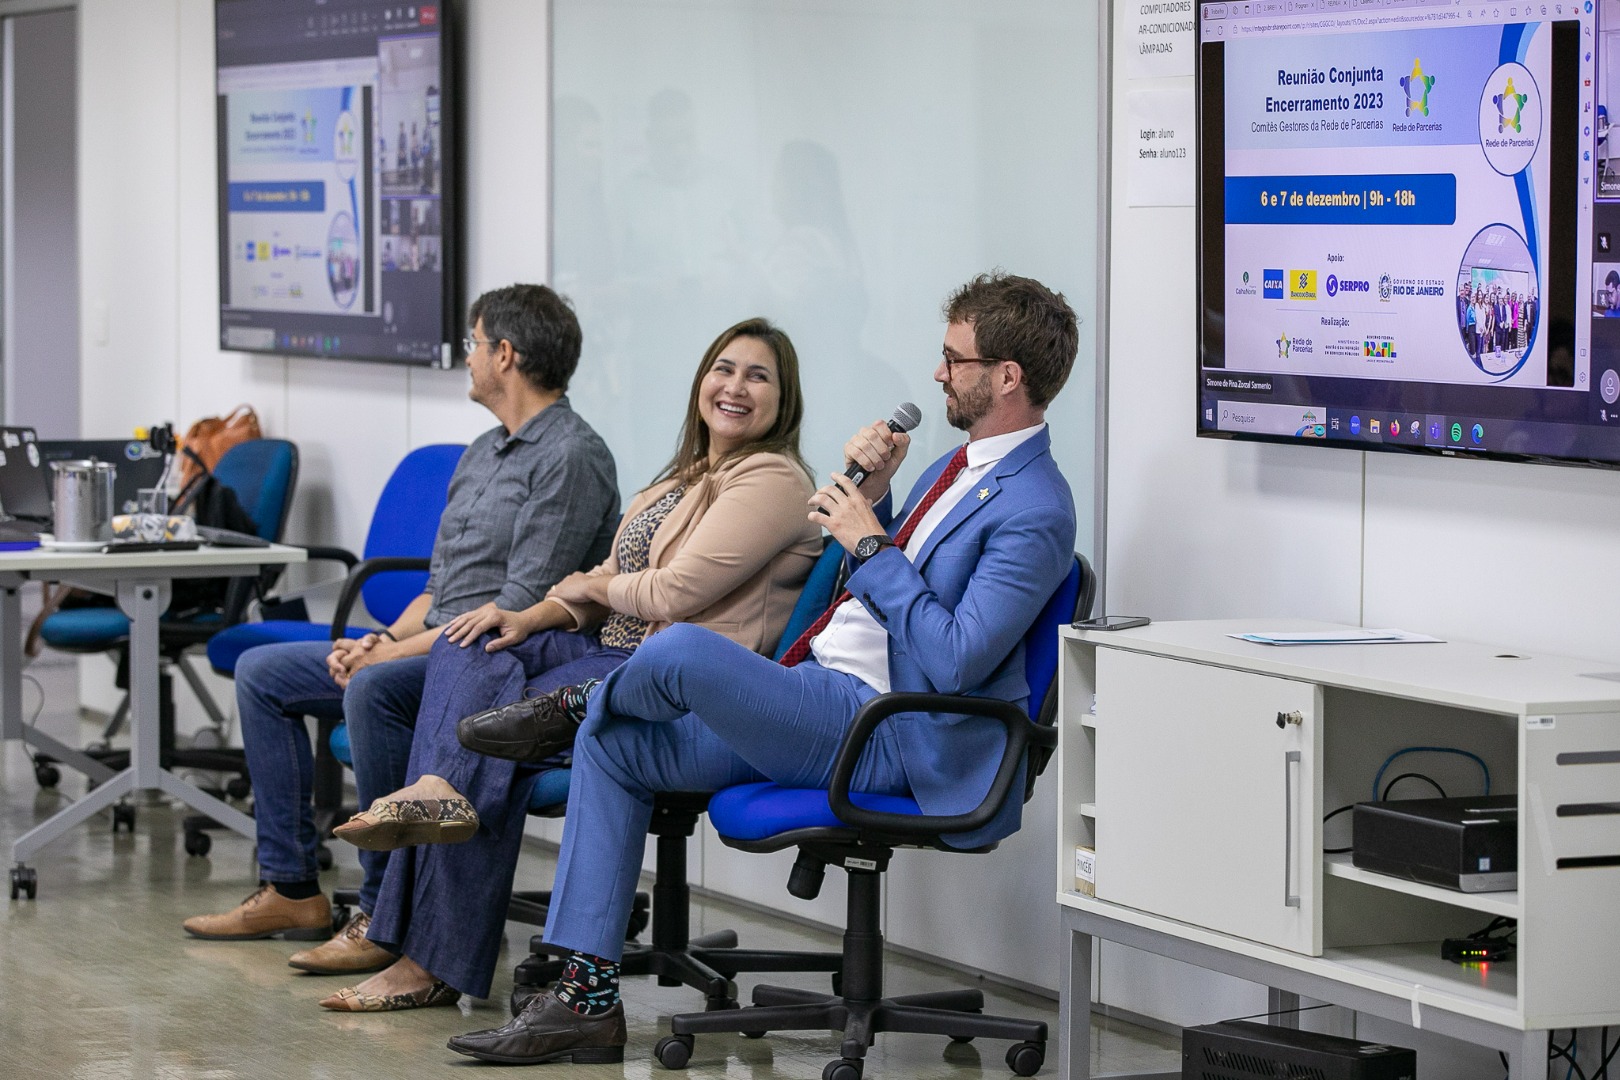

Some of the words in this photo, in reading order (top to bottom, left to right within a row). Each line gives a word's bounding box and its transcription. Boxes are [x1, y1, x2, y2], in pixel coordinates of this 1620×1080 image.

[1140, 1, 1191, 15] COMPUTADORES
[1139, 42, 1173, 54] LÂMPADAS
[1278, 69, 1325, 86] Reunião
[1329, 67, 1384, 87] Conjunta
[1265, 95, 1350, 113] Encerramento
[1353, 92, 1384, 109] 2023
[1251, 120, 1278, 133] Comitês
[1279, 119, 1309, 132] Gestores
[1310, 119, 1319, 131] da
[1320, 119, 1339, 131] Rede
[1340, 118, 1350, 130] de
[1351, 117, 1384, 130] Parcerias
[1392, 123, 1407, 132] Rede
[1407, 122, 1416, 132] de
[1416, 121, 1443, 132] Parcerias
[1140, 128, 1158, 141] Login:
[1158, 128, 1175, 139] aluno
[1485, 139, 1500, 147] Rede
[1500, 138, 1509, 147] de
[1508, 137, 1535, 147] Parcerias
[1139, 148, 1159, 159] Senha:
[1160, 147, 1187, 159] aluno123
[1261, 191, 1268, 206] 6
[1270, 194, 1278, 206] e
[1280, 191, 1287, 206] 7
[1290, 191, 1304, 206] de
[1306, 190, 1361, 206] dezembro
[1369, 190, 1384, 206] 9h
[1394, 189, 1416, 206] 18h
[1327, 253, 1345, 263] Apoio:
[1264, 280, 1283, 290] CAIXA
[1339, 280, 1370, 293] SERPRO
[1393, 286, 1405, 295] RIO
[1406, 286, 1415, 296] DE
[1416, 286, 1444, 297] JANEIRO
[1320, 316, 1350, 328] Realização:
[1292, 338, 1304, 346] Rede
[1206, 378, 1222, 387] Simone
[1251, 381, 1272, 390] Sarmento
[1232, 412, 1256, 424] Pesquisar
